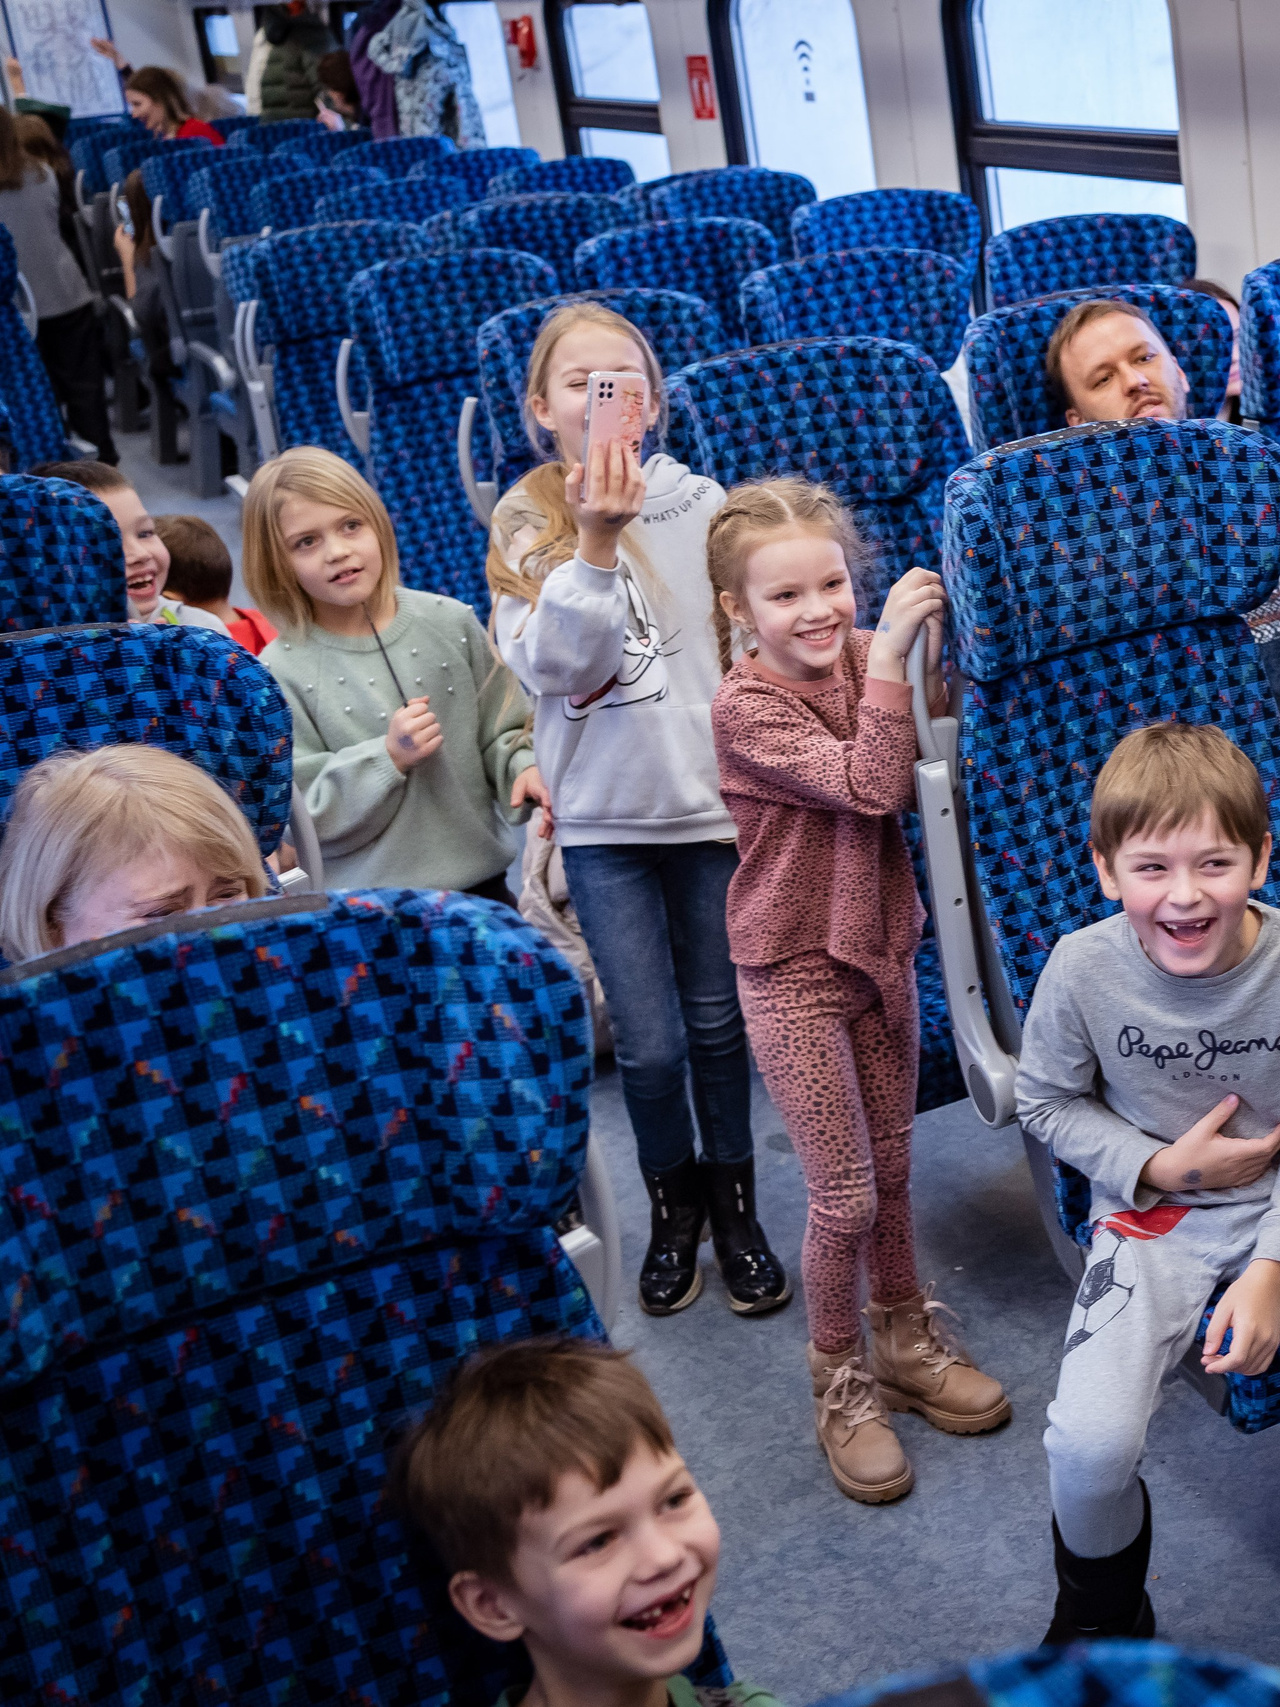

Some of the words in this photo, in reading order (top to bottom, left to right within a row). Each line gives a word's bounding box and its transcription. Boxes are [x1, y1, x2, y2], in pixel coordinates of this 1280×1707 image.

[679, 499, 692, 513] UP
[1118, 1025, 1194, 1069] Pepe
[1172, 1071, 1241, 1081] LONDON
